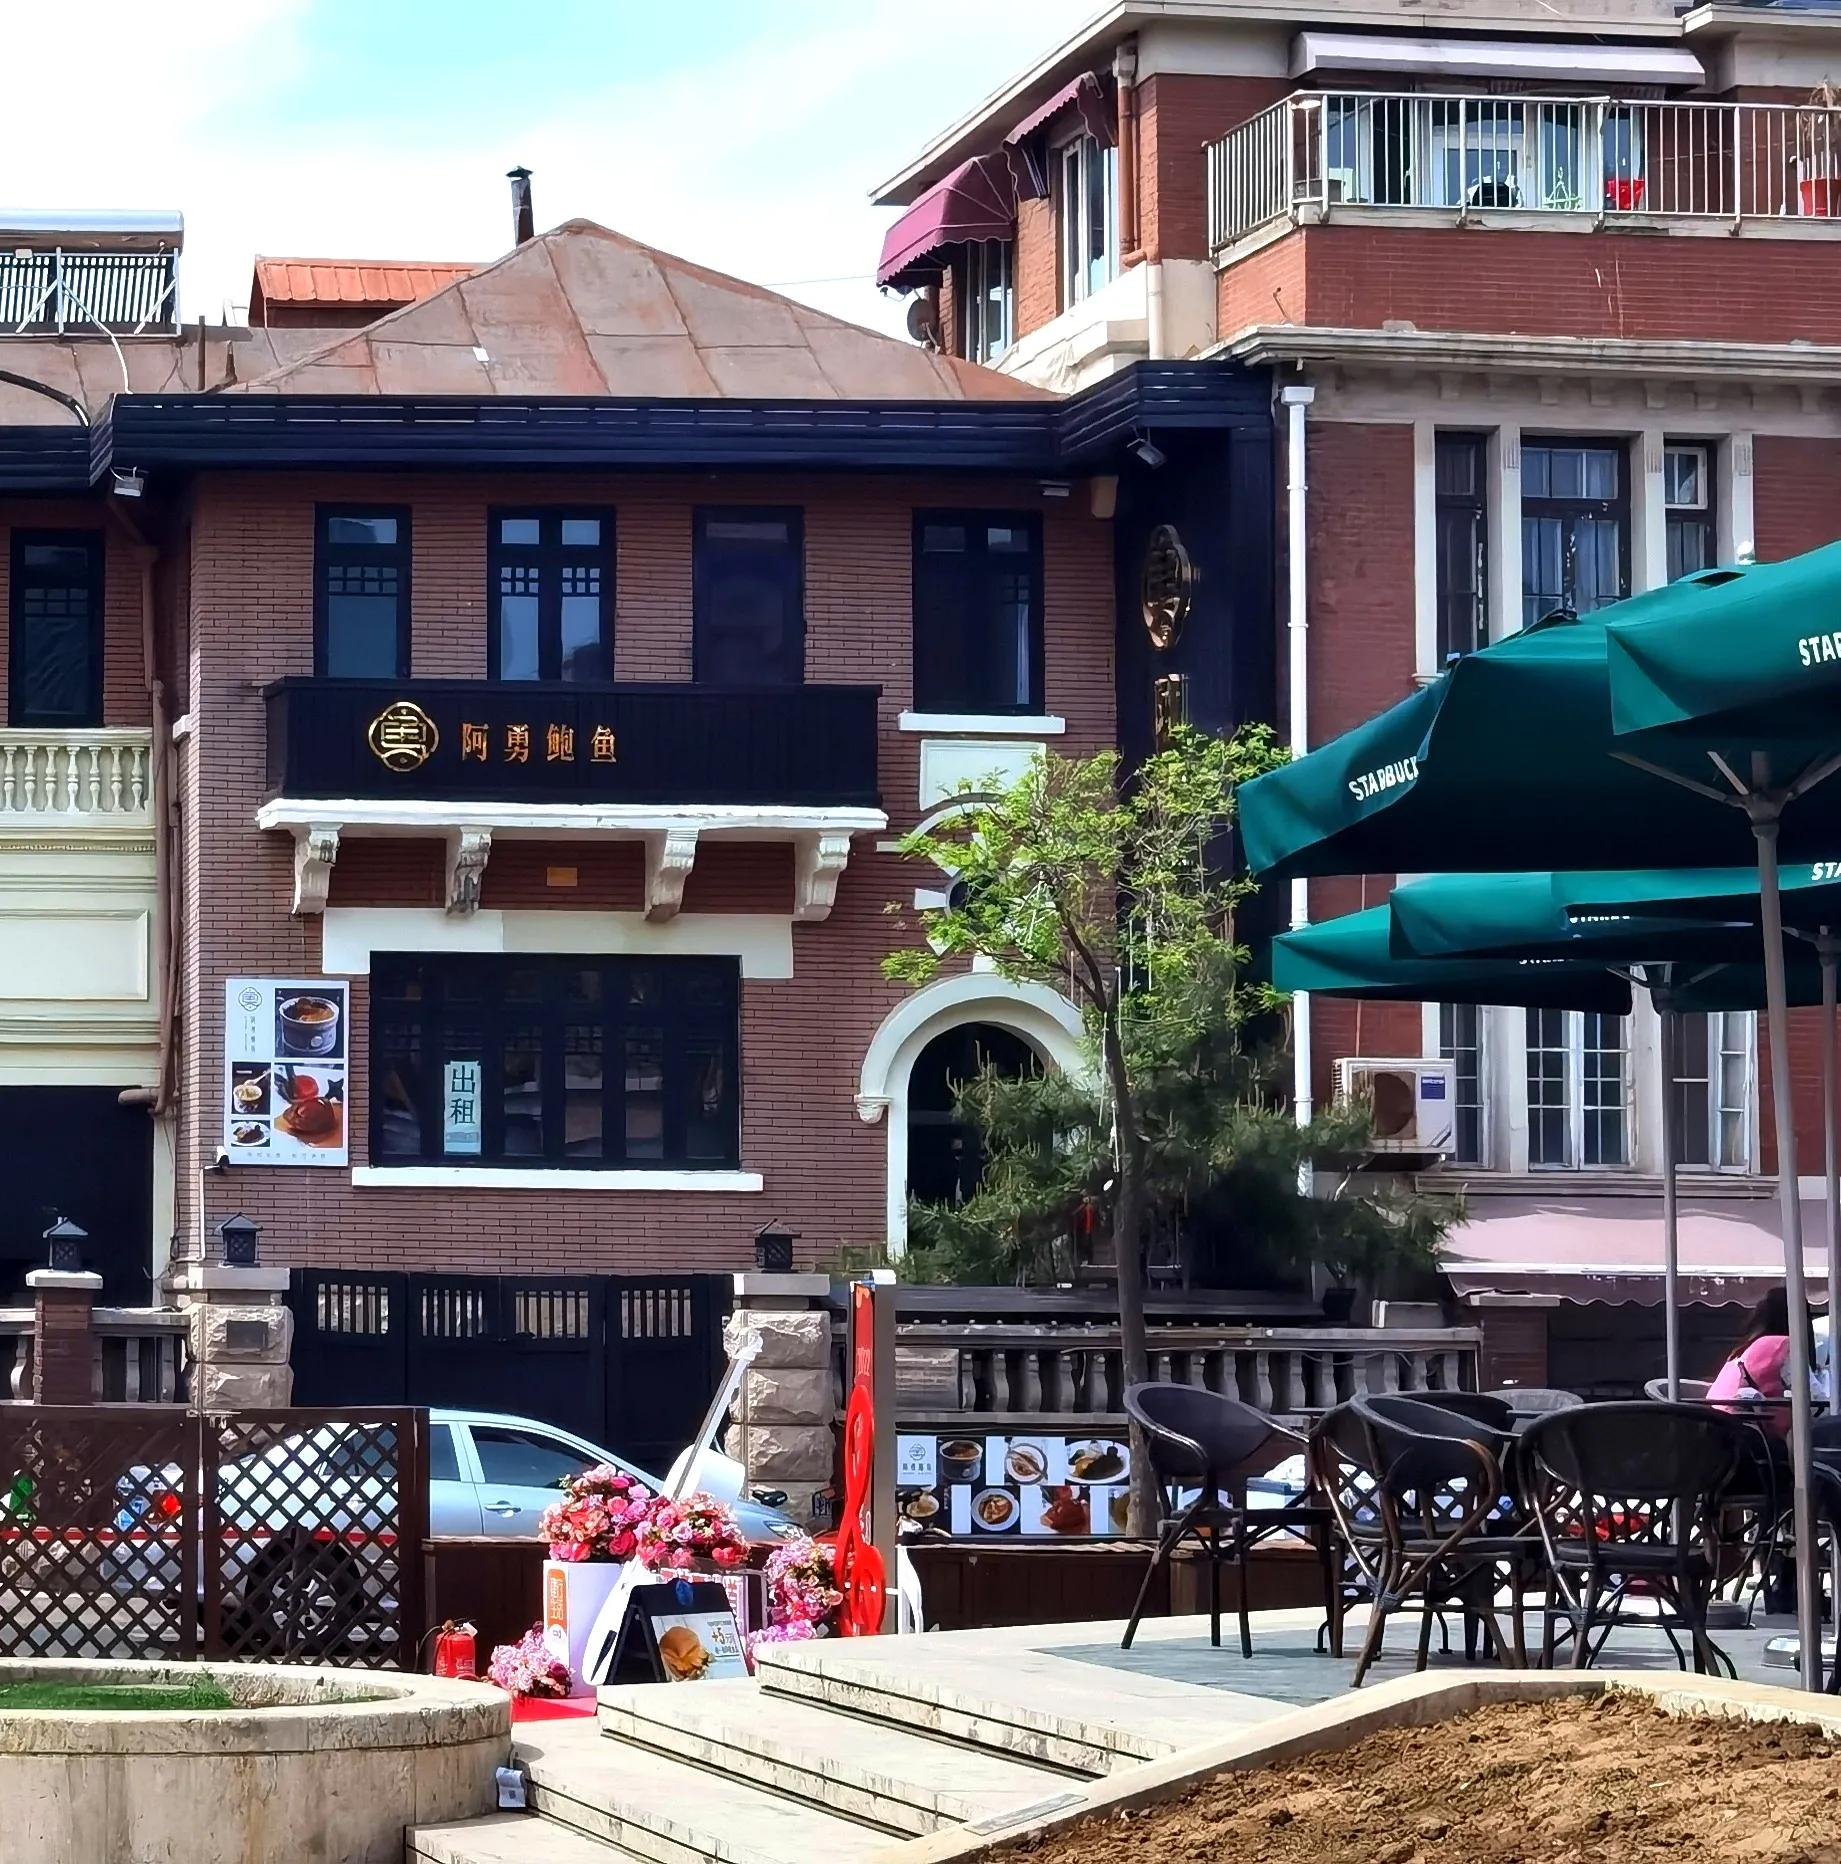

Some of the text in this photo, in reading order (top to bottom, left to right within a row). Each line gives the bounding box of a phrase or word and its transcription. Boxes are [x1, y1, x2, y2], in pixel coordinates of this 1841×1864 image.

[462, 723, 617, 763] 阿勇鲍鱼
[449, 1064, 476, 1125] 出租
